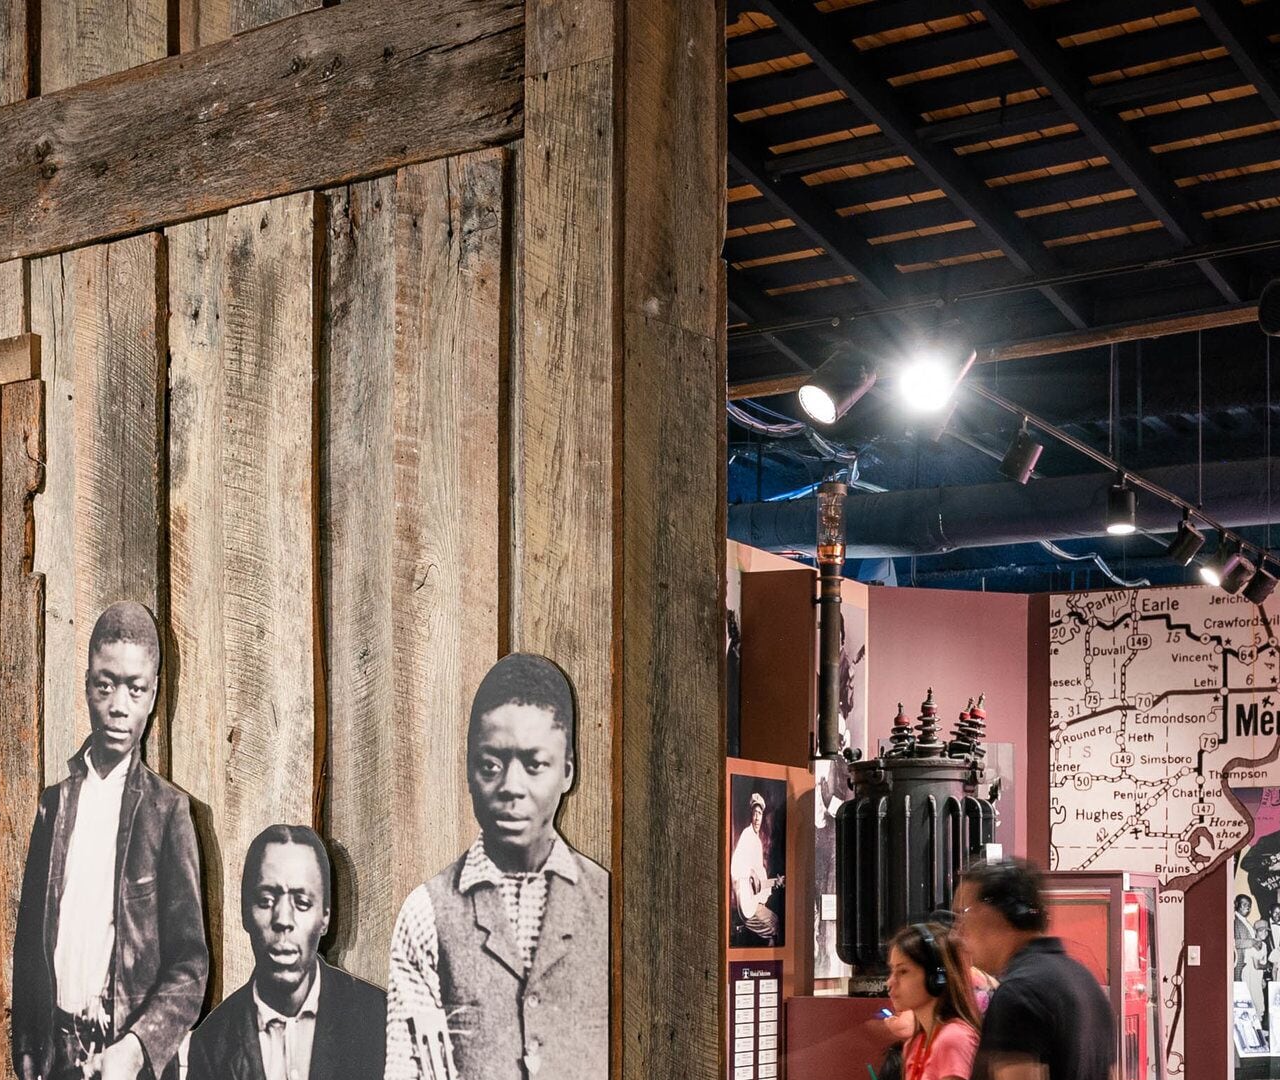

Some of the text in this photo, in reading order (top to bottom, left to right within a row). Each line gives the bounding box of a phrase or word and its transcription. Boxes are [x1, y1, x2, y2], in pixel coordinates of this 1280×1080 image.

[1086, 590, 1127, 613] Parkin
[1142, 596, 1180, 612] Earle
[1209, 595, 1250, 605] Jericho
[1051, 627, 1067, 640] 20
[1166, 631, 1182, 644] 15
[1131, 636, 1149, 647] 149
[1092, 645, 1126, 657] Duvall
[1240, 650, 1255, 661] 64
[1171, 652, 1213, 664] Vincent
[1194, 678, 1218, 688] Lehi
[1087, 695, 1099, 706] 75
[1137, 697, 1151, 708] 70
[1067, 704, 1081, 718] 31
[1135, 712, 1206, 724] Edmondson
[1062, 728, 1097, 745] Round
[1128, 732, 1155, 743] Heth
[1203, 736, 1218, 748] 79
[1115, 754, 1132, 765] 149
[1140, 755, 1192, 765] Simsboro
[1209, 769, 1268, 781] Thompson
[1076, 775, 1090, 788] 50
[1172, 788, 1222, 799] Chatfield
[1196, 805, 1212, 814] 147
[1075, 808, 1124, 824] Hughes
[1209, 816, 1248, 828] Horse-
[1215, 829, 1242, 839] shoe
[1178, 844, 1191, 854] 50
[1154, 864, 1191, 874] Bruins
